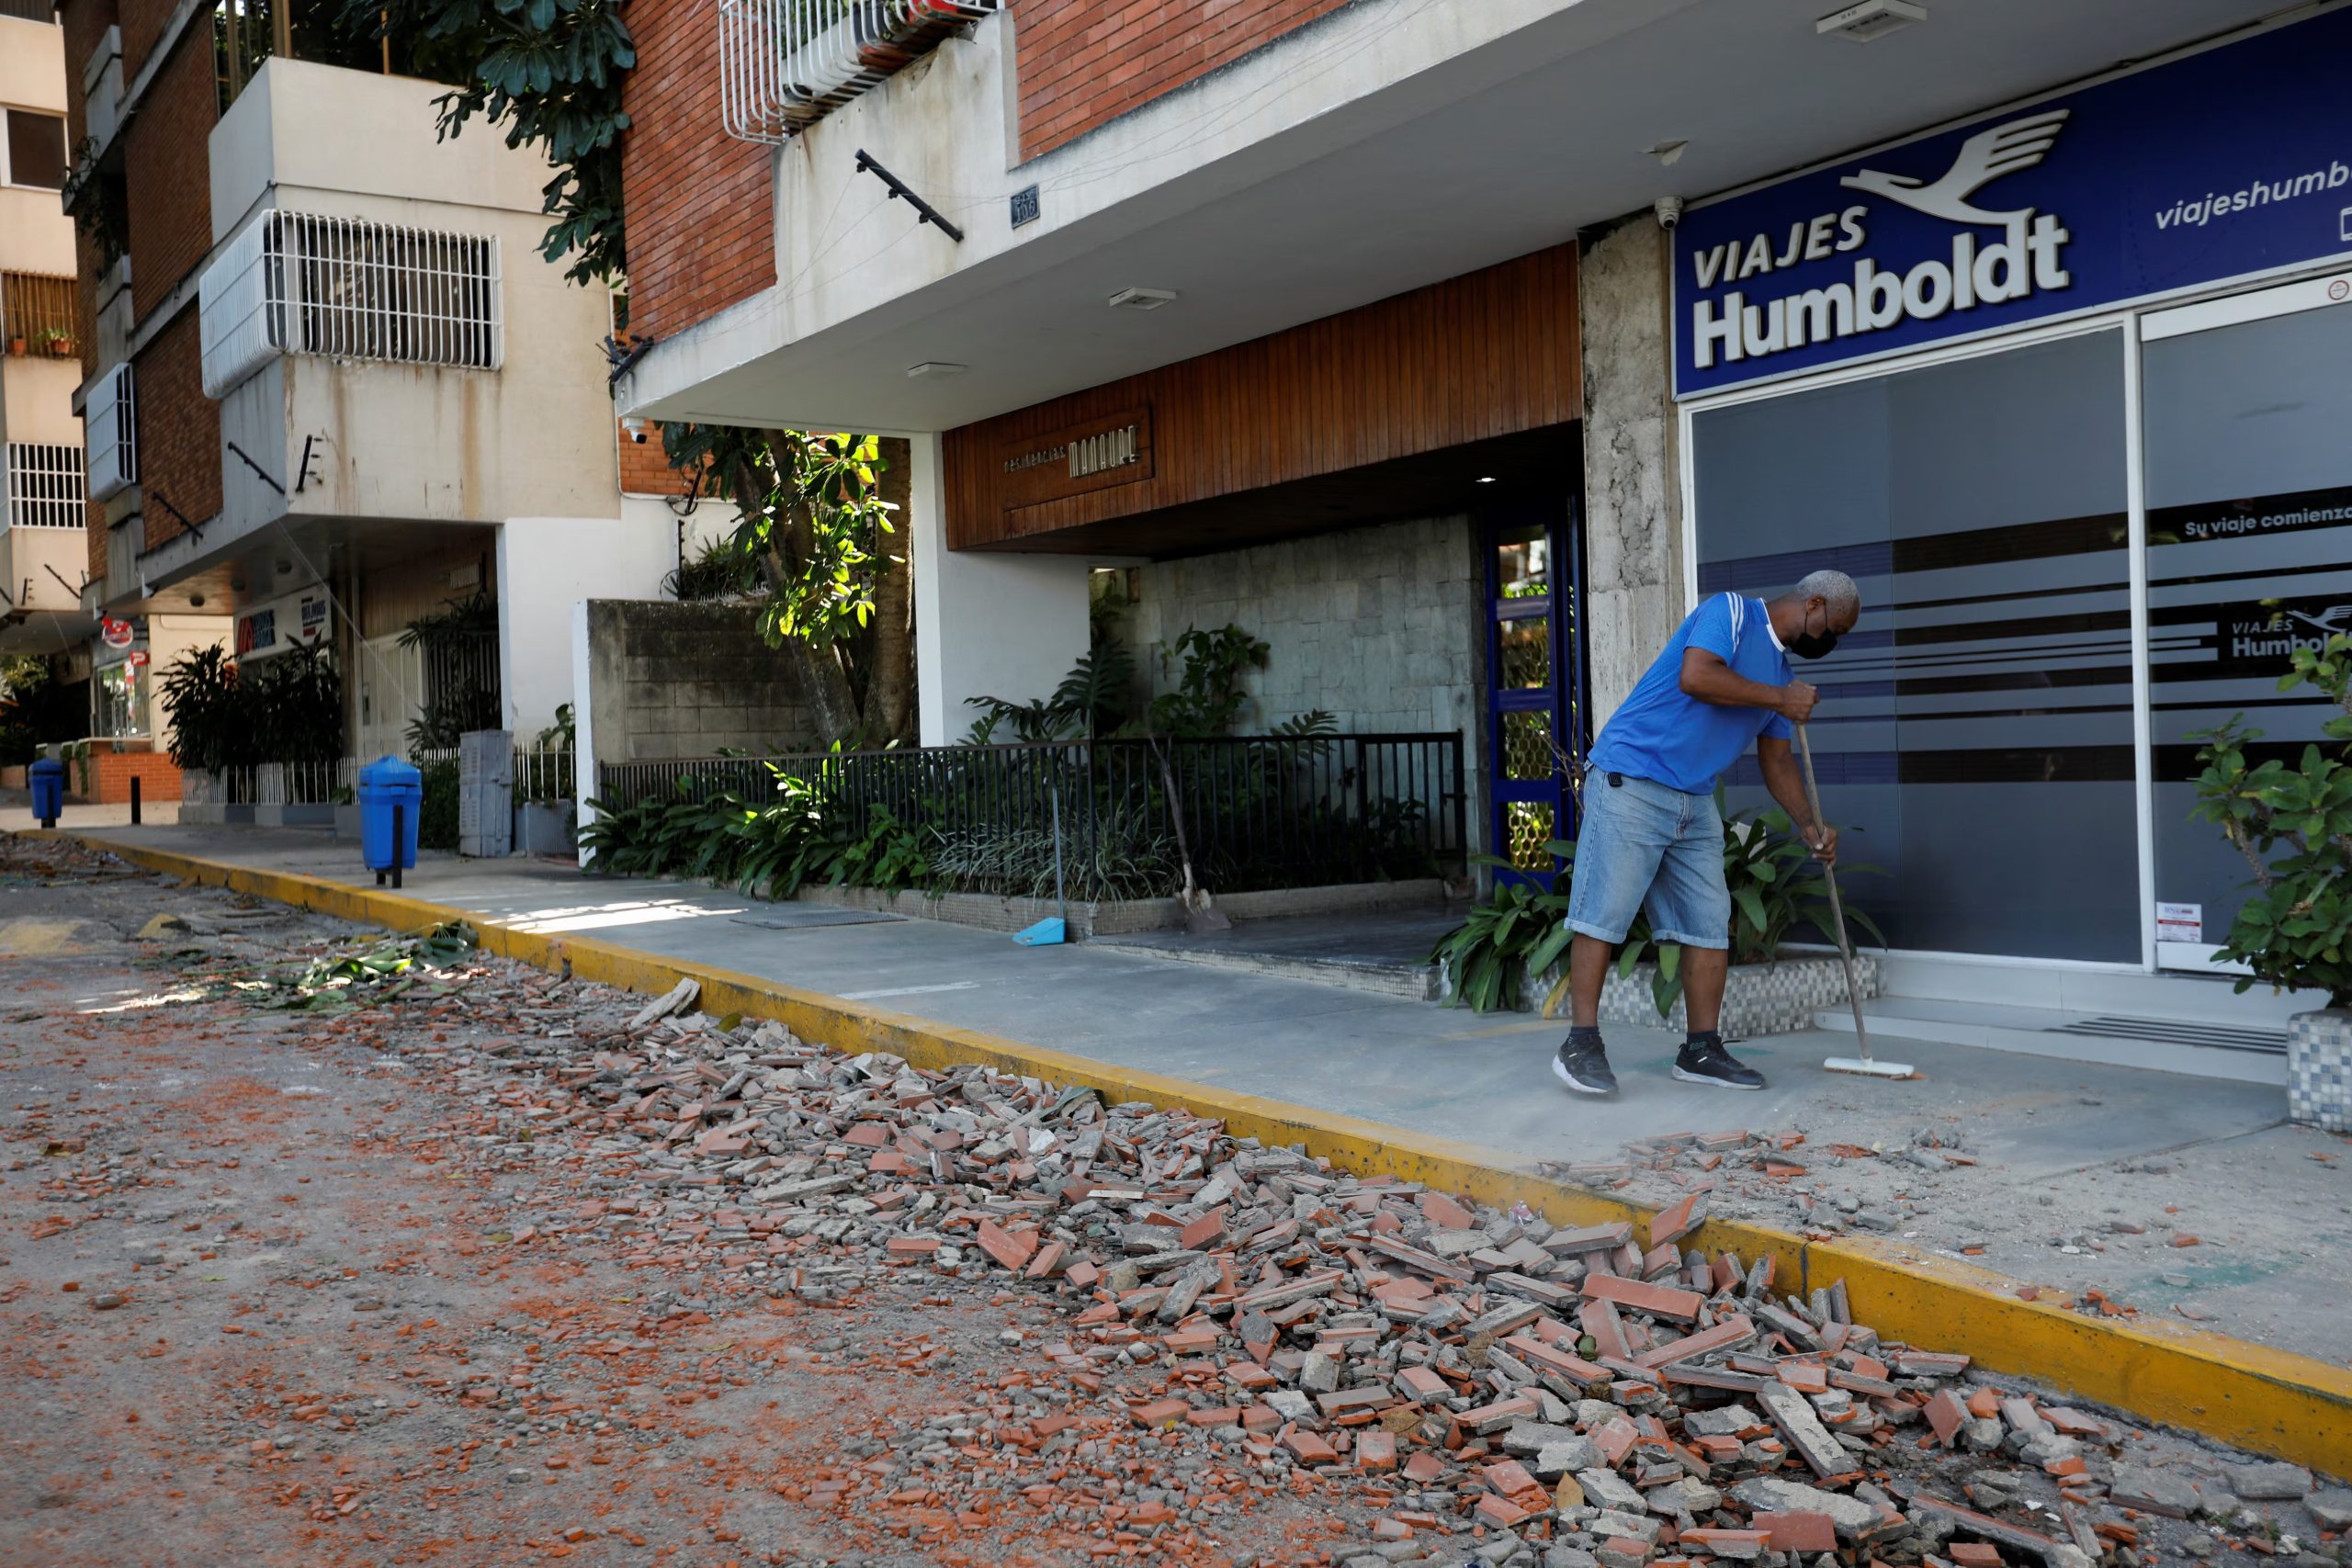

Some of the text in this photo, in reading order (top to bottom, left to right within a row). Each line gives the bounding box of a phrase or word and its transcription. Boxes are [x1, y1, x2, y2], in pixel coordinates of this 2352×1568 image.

[2155, 160, 2352, 230] viajeshumb
[1692, 206, 1869, 290] VIAJES
[1693, 213, 2071, 368] Humboldt
[2185, 521, 2207, 536] Su
[2211, 515, 2257, 533] viaje
[2232, 619, 2294, 634] VIAJES
[2232, 631, 2352, 658] Humbol
